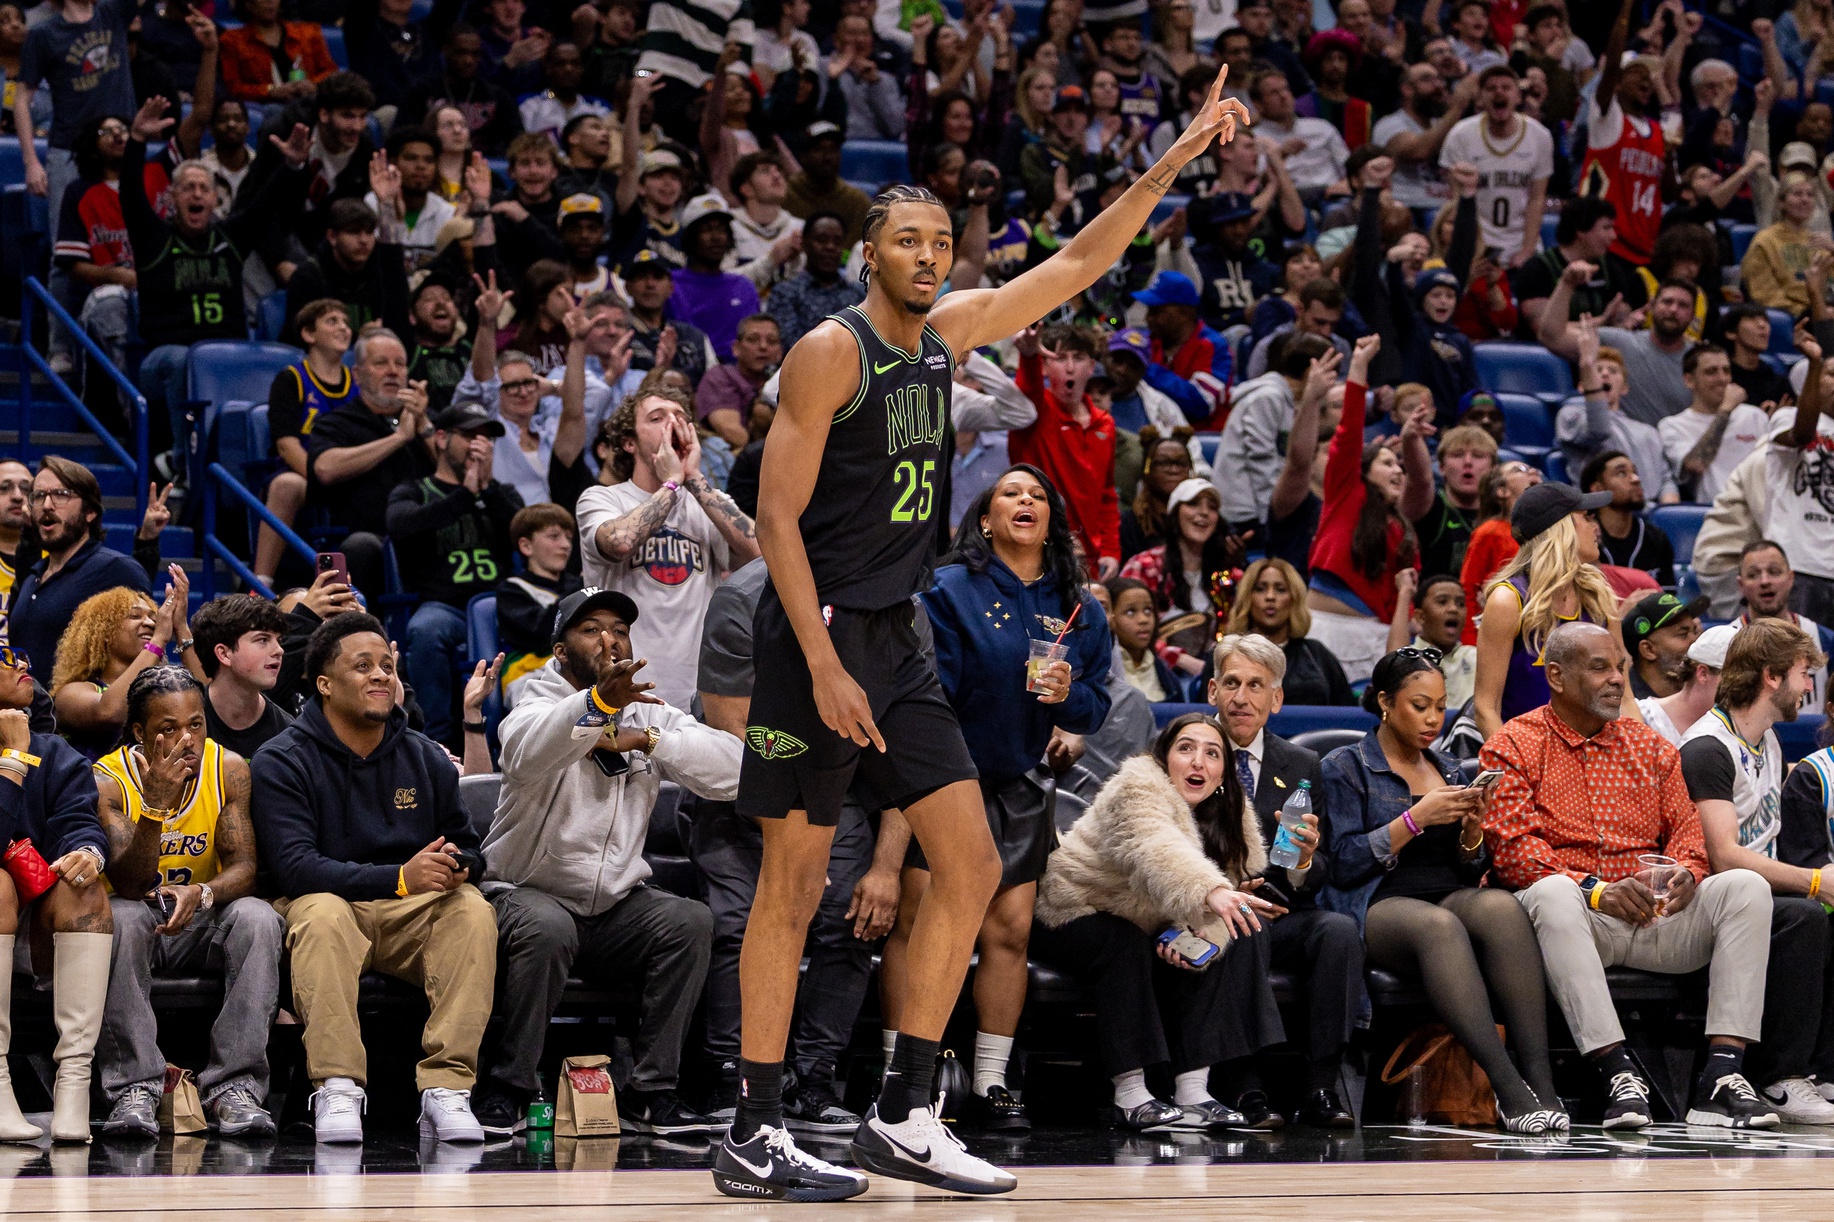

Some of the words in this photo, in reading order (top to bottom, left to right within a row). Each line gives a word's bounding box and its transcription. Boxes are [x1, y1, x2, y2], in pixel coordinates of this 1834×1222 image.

[1493, 197, 1509, 227] 0
[1631, 180, 1656, 217] 14
[191, 292, 224, 325] 15
[892, 460, 936, 522] 25
[448, 548, 498, 584] 25
[632, 536, 703, 570] JETLIFE
